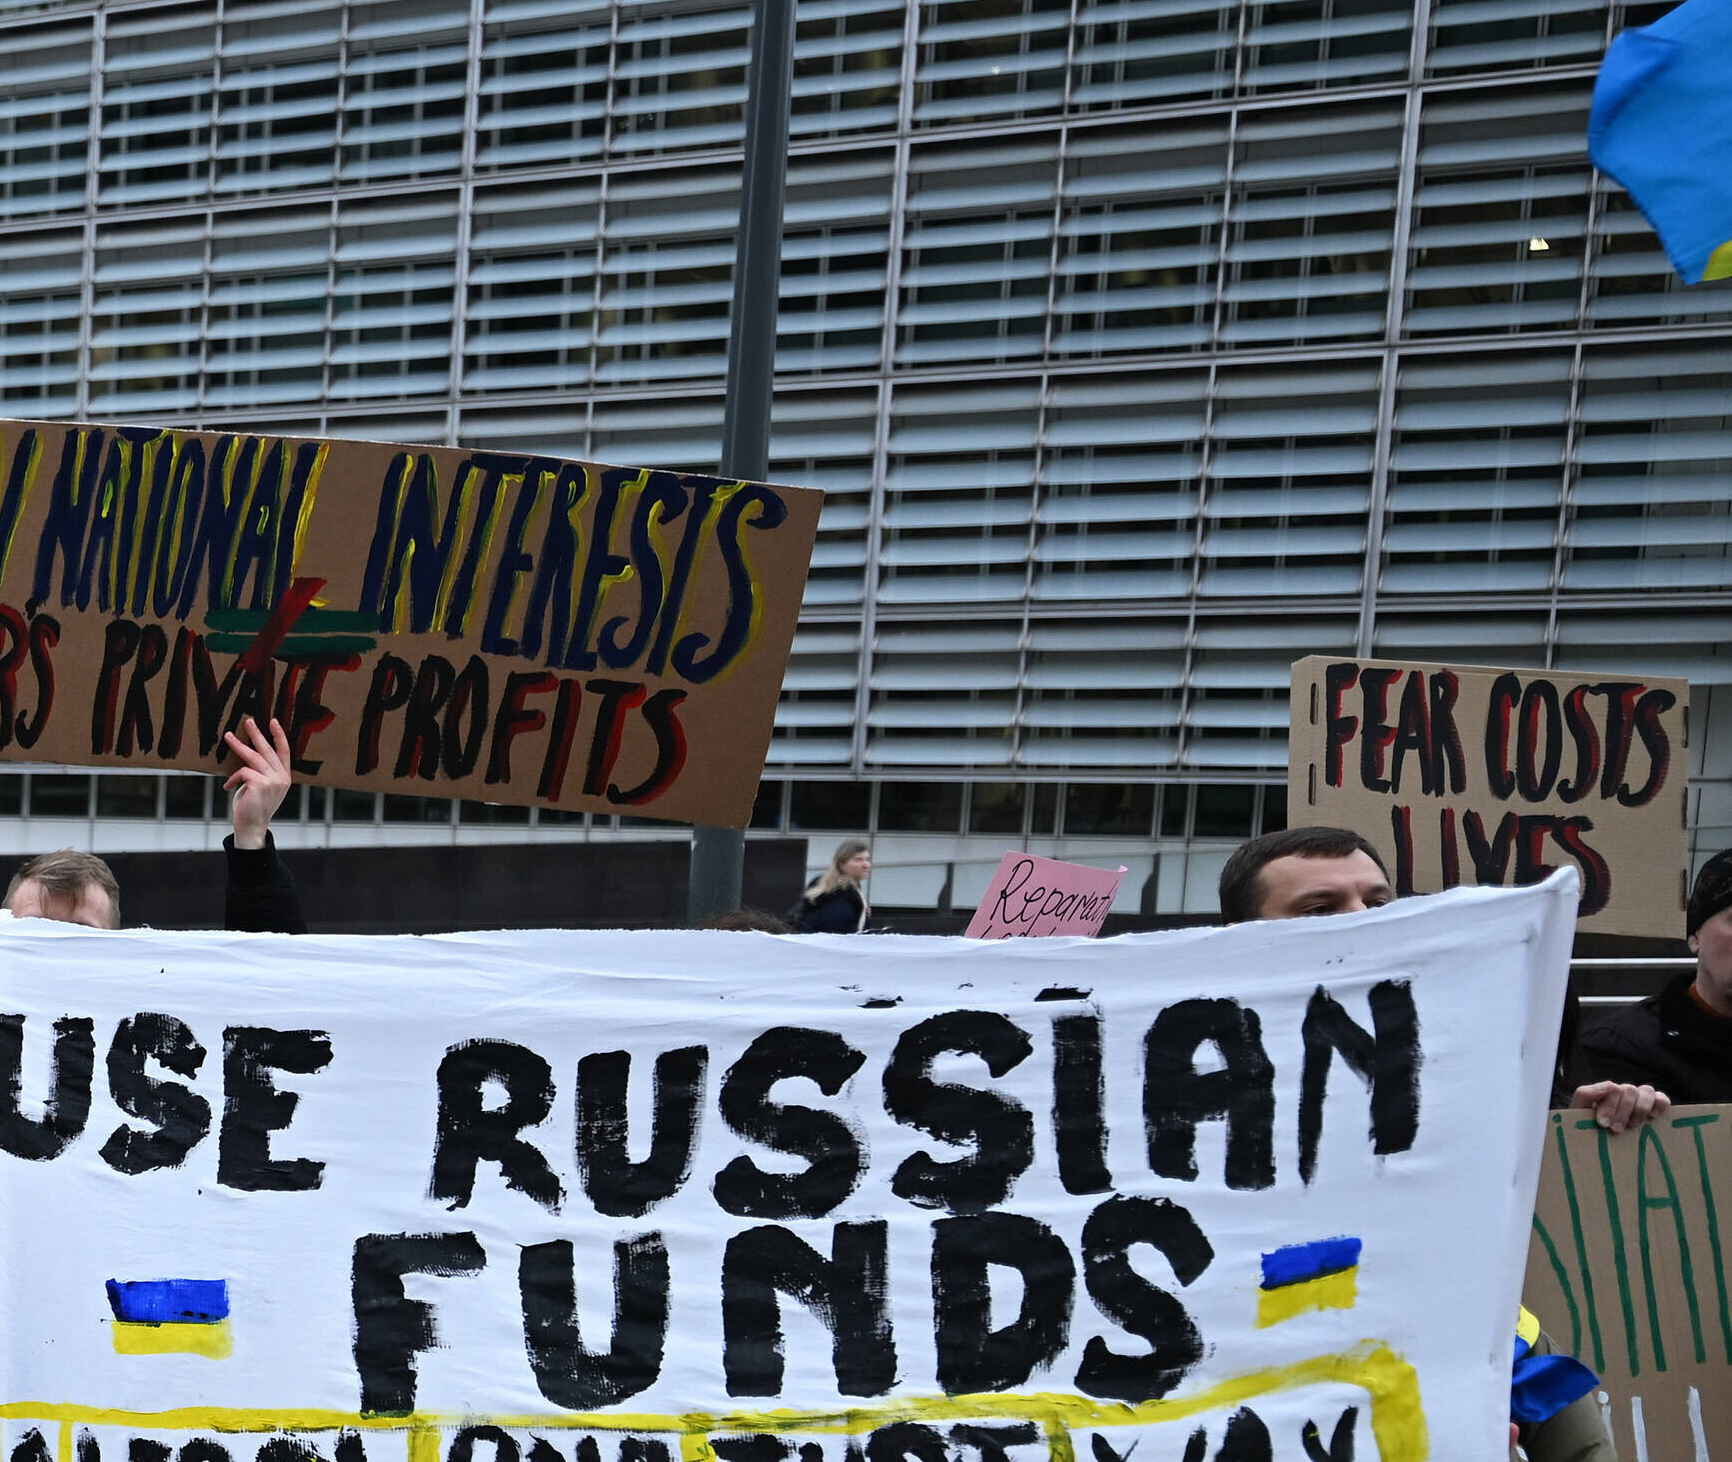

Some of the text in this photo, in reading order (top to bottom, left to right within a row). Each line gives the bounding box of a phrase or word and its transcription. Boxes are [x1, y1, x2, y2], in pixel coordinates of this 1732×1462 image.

[32, 425, 330, 614] NATIONAL
[361, 451, 787, 684] INTERESTS
[355, 643, 691, 807] PROFITS
[1325, 662, 1677, 807] FEAR COSTS
[1389, 804, 1613, 918] LIVES
[426, 975, 1420, 1221] RUSSIAN
[352, 1196, 1215, 1421] FUNDS
